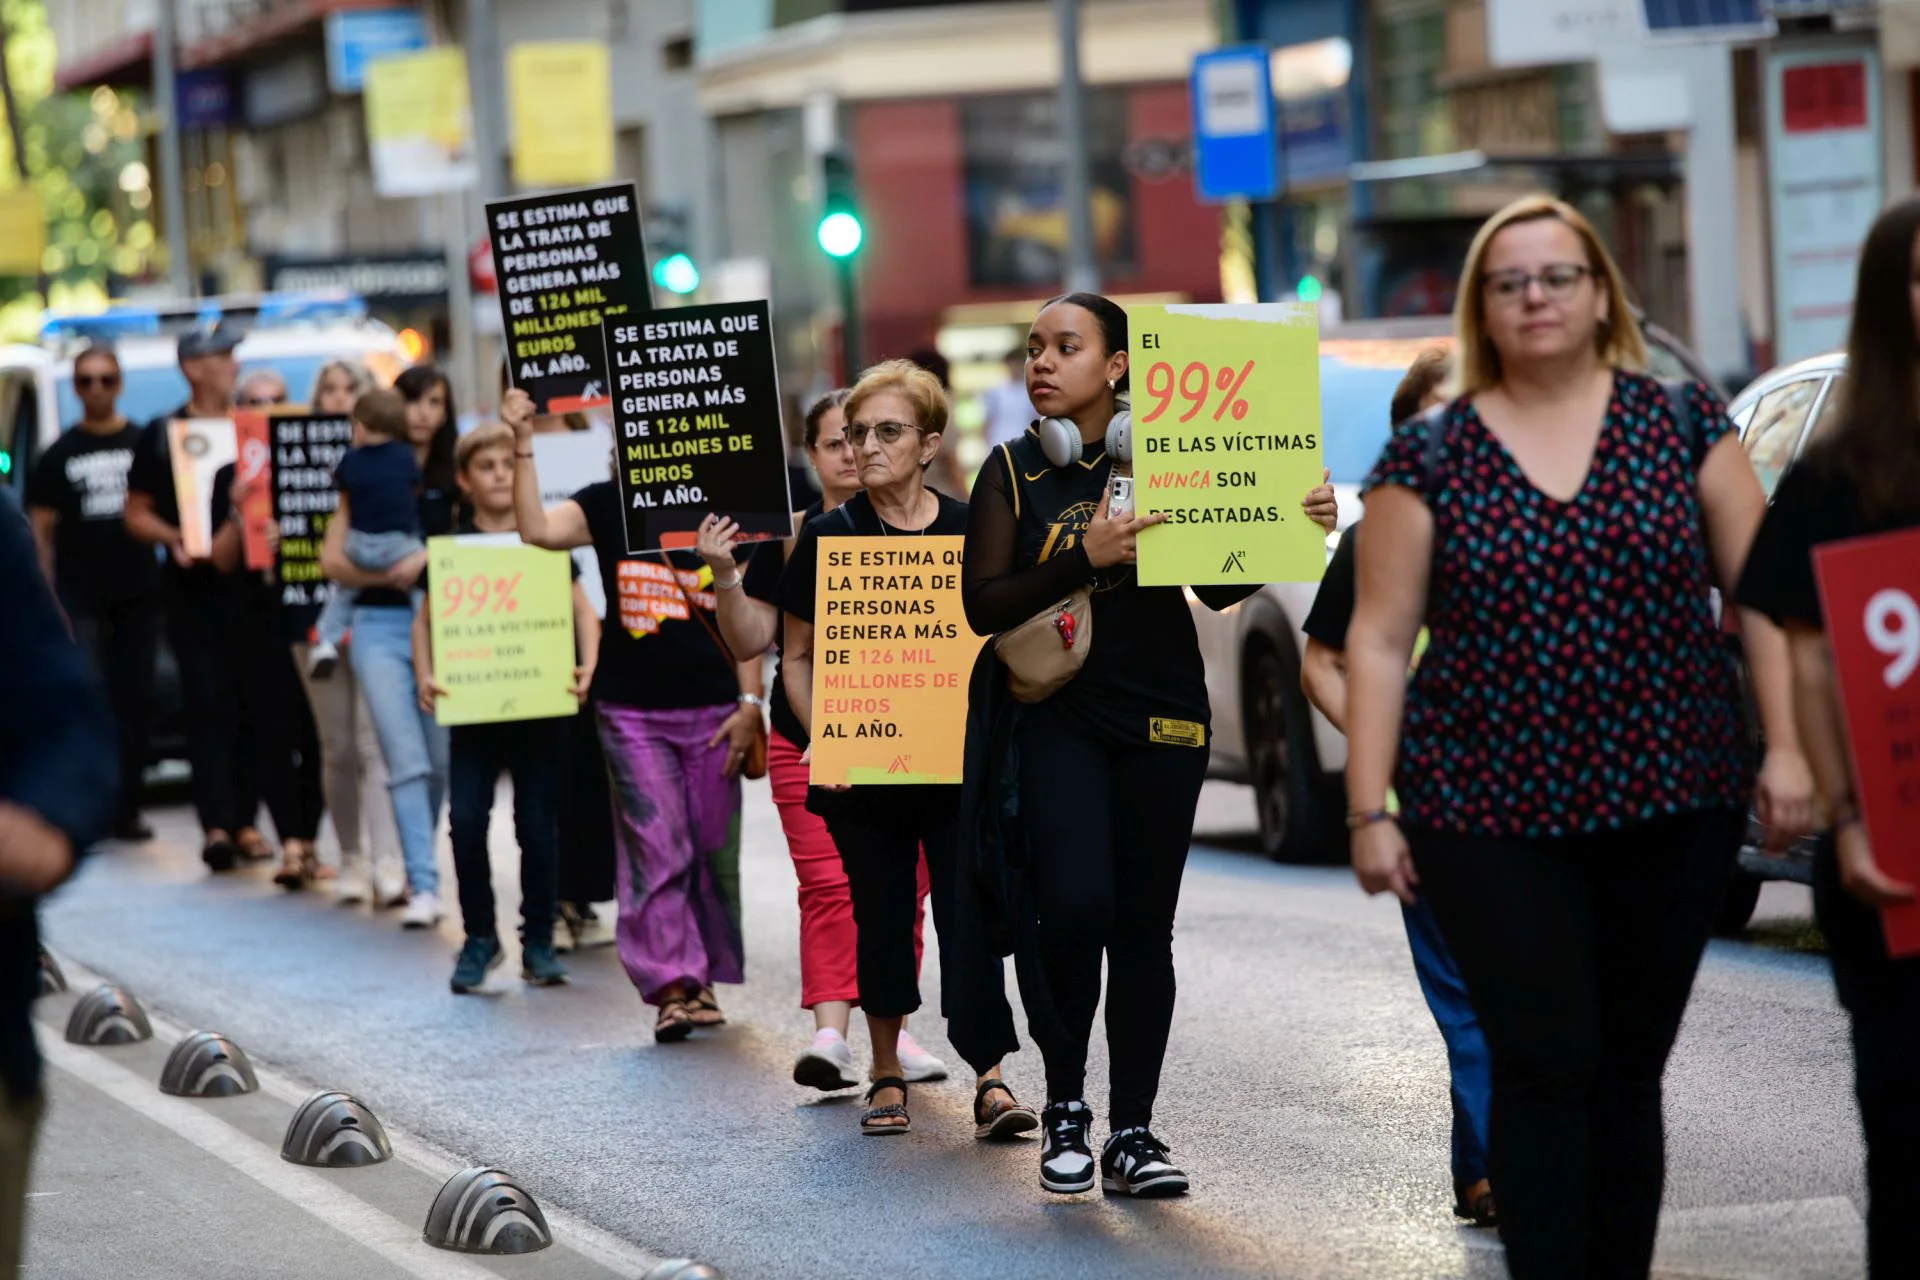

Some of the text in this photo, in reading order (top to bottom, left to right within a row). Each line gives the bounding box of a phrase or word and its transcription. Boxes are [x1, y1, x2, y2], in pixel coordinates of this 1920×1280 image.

[496, 195, 630, 230] SE ESTIMA QUE
[500, 219, 612, 251] LA TRATA DE
[502, 243, 598, 273] PERSONAS
[506, 261, 621, 294] GENERA MÁS
[509, 287, 607, 316] DE 126 MIL
[513, 309, 602, 336] MILLONES
[614, 314, 760, 344] SE ESTIMA QUE
[516, 334, 576, 358] EUROS
[1142, 334, 1161, 349] El
[520, 353, 591, 379] AL AÑO.
[616, 341, 739, 368] LA TRATA DE
[619, 365, 723, 391] PERSONAS
[622, 384, 746, 415] GENERA MÁS
[1141, 359, 1256, 424] 99%
[624, 413, 730, 438] DE 126 MIL
[627, 435, 754, 462] MILLONES DE
[1146, 432, 1317, 453] DE LAS VÍCTIMAS
[277, 445, 305, 466] LA
[629, 463, 694, 485] EUROS
[1149, 470, 1257, 489] NUNCA SON
[632, 484, 709, 509] AL AÑO.
[279, 513, 307, 536] DE
[828, 551, 853, 567] SE
[860, 551, 935, 566] ESTIMA
[282, 584, 310, 605] AL
[441, 571, 524, 619] 99%
[619, 580, 638, 594] LA
[828, 575, 957, 591] LA TRATA DE
[827, 599, 936, 616] PERSONAS
[826, 620, 958, 641] GENERA MÁS
[825, 649, 937, 665] DE 126 MIL
[824, 673, 959, 689] MILLONES DE
[823, 698, 891, 714] EUROS
[822, 719, 903, 738] AL AÑO.
